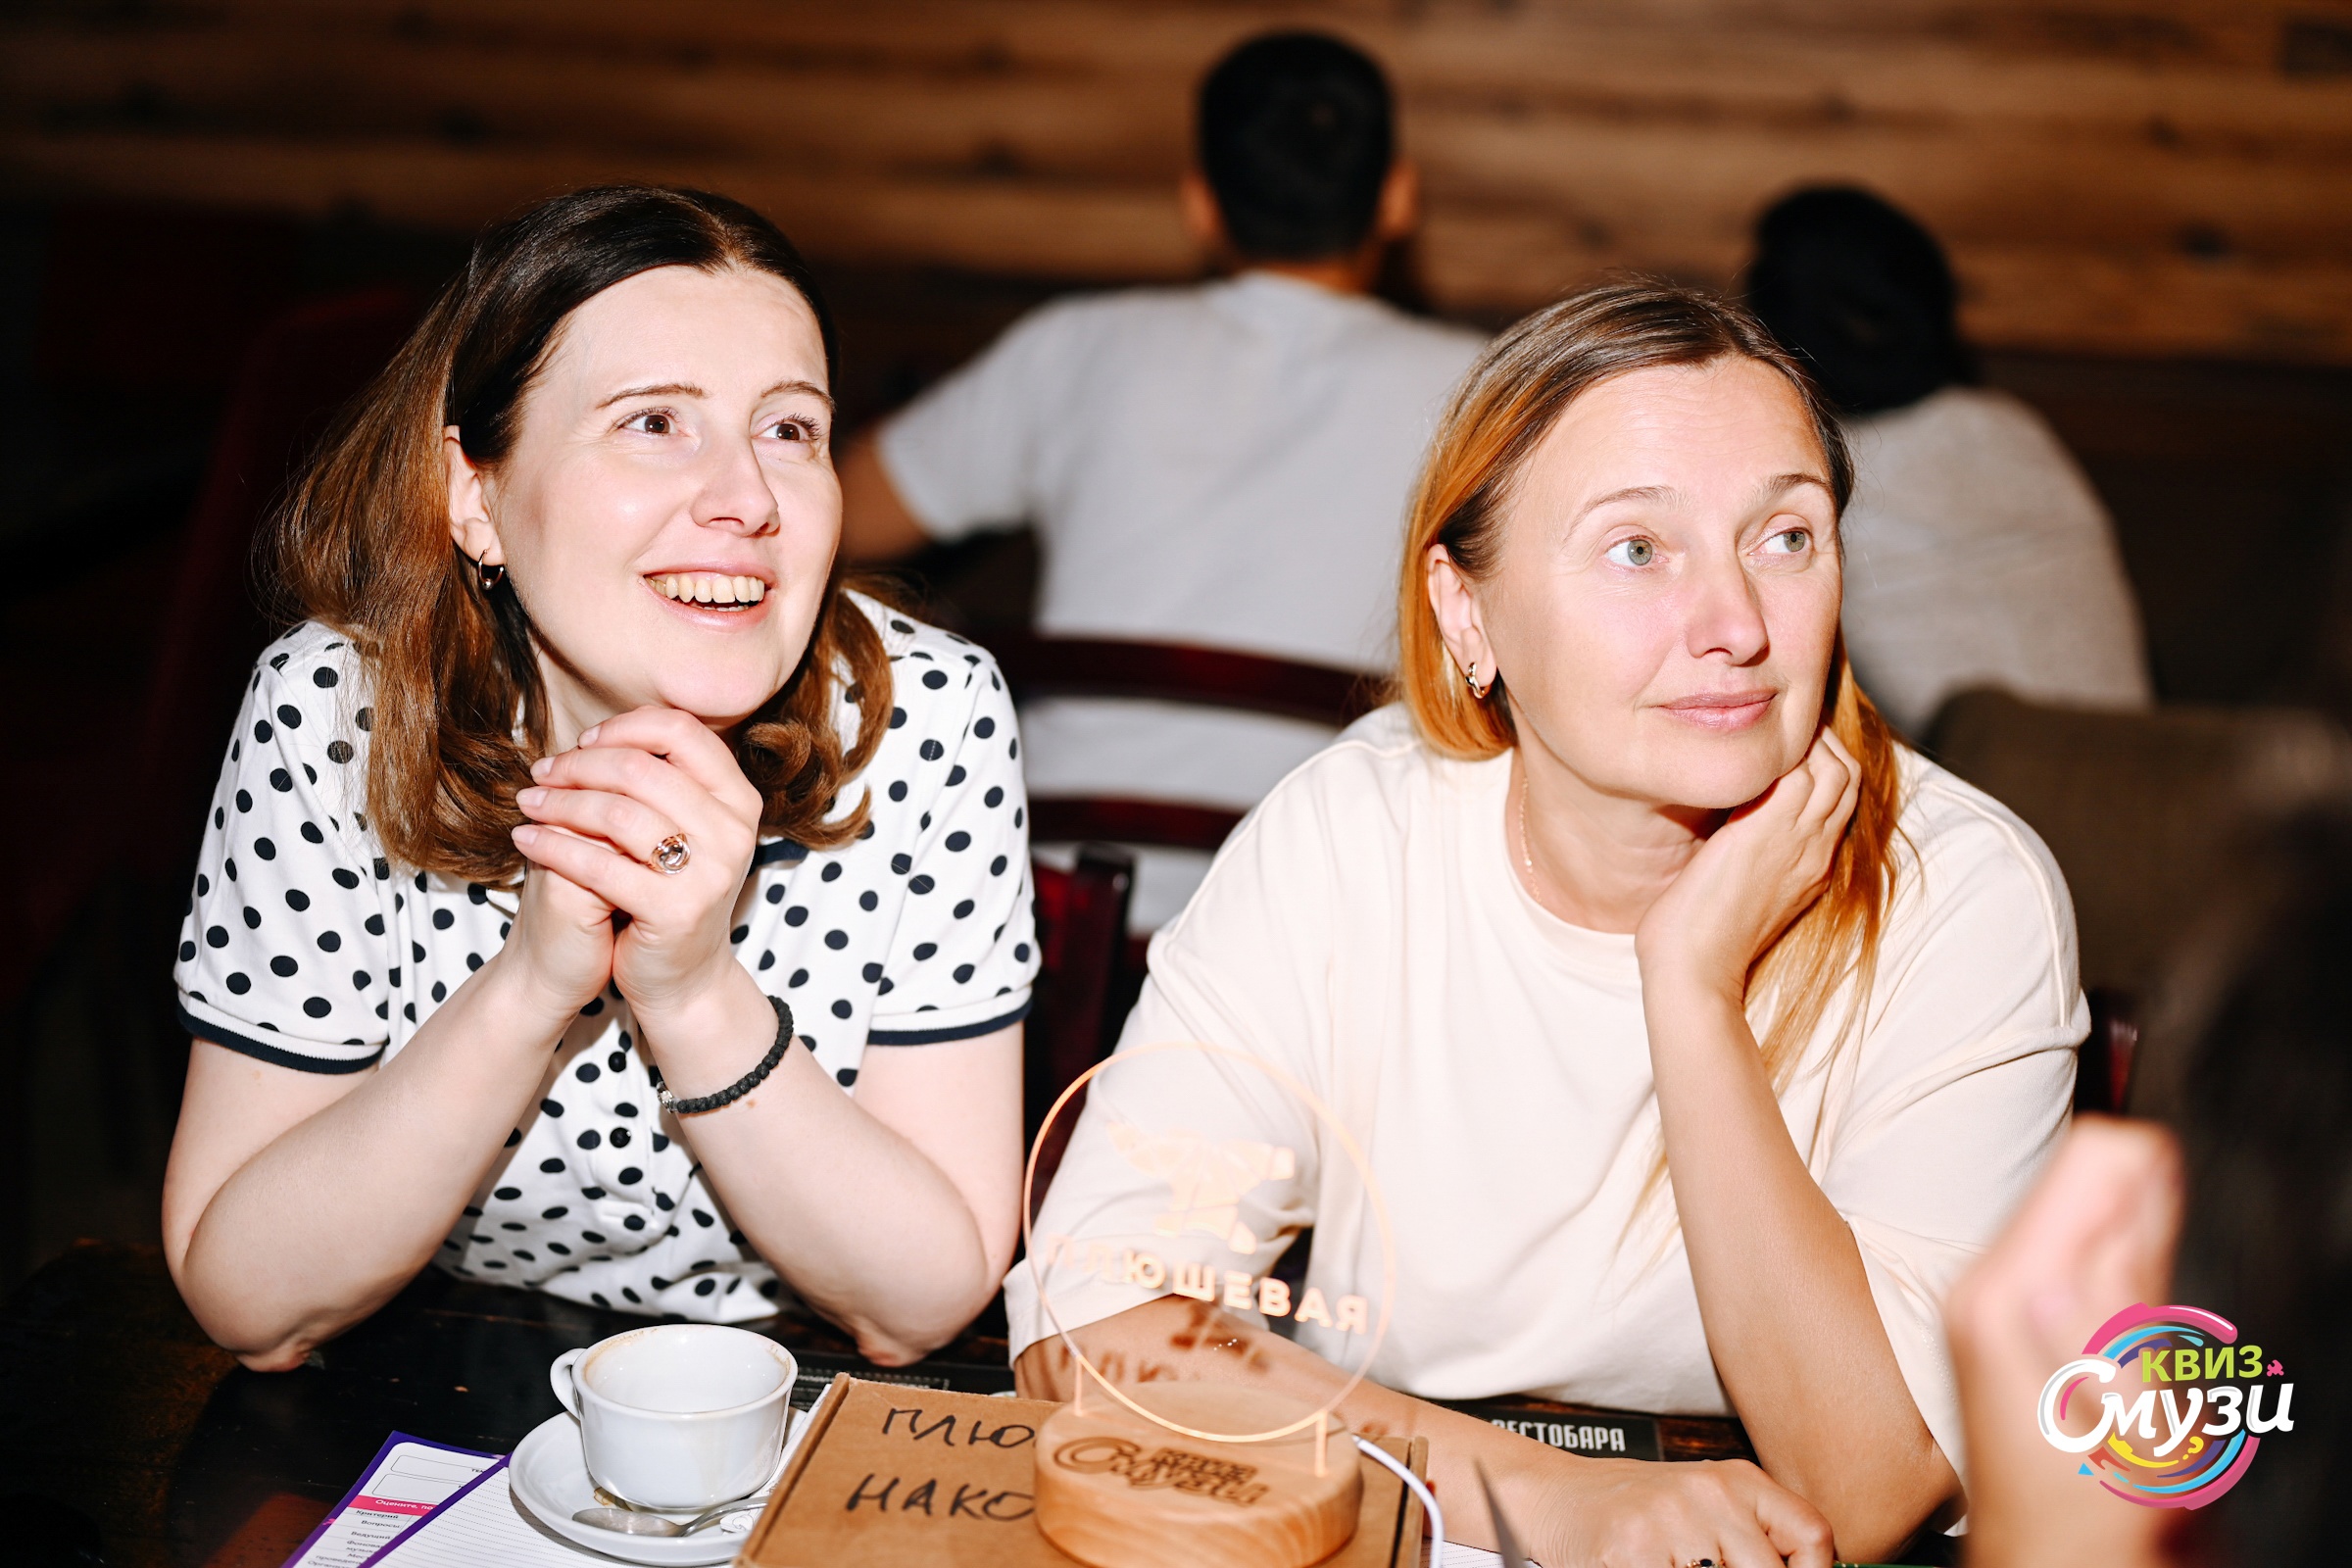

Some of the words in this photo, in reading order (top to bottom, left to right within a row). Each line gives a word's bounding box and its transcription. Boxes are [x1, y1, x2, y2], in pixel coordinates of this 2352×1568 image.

[1046, 1232, 1368, 1335] ПЛЮШЕВАЯ
[882, 1407, 1036, 1448] ПЛЮ
[347, 1540, 383, 1548] Фонова
